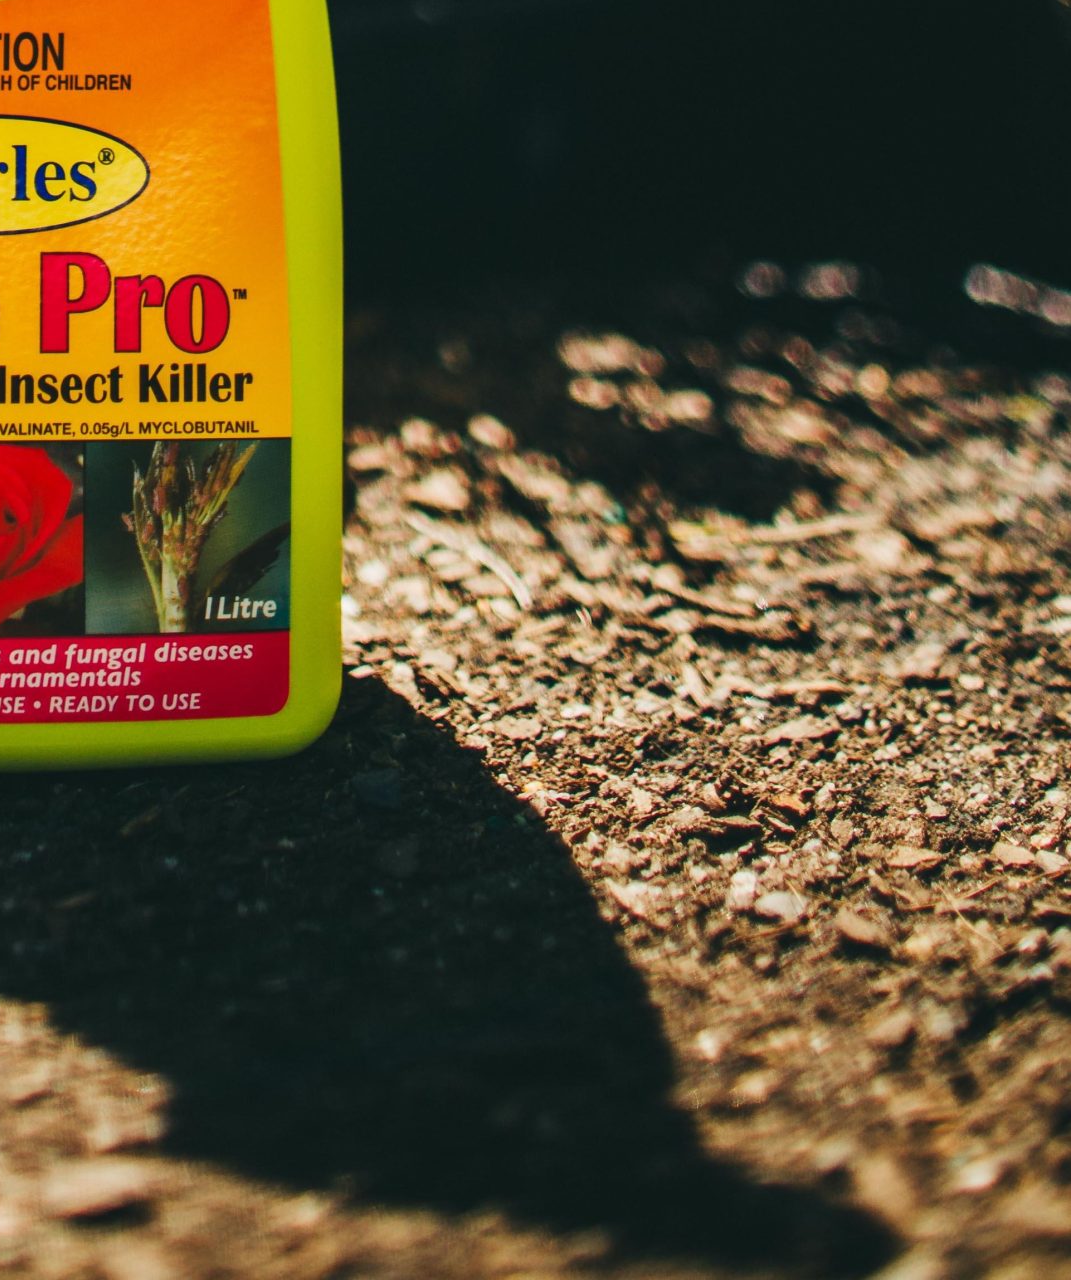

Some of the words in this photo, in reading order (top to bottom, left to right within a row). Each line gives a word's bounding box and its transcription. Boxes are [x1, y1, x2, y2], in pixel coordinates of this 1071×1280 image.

[17, 75, 41, 91] OF
[45, 75, 132, 91] CHILDREN
[138, 362, 254, 402] Killer
[79, 421, 134, 437] 0.05g/L
[138, 420, 259, 435] MYCLOBUTANIL
[216, 596, 277, 619] Litre
[9, 644, 56, 665] and
[64, 643, 146, 670] fungal
[154, 640, 254, 662] diseases
[49, 693, 120, 713] READY
[125, 693, 157, 712] TO
[162, 692, 202, 711] USE
